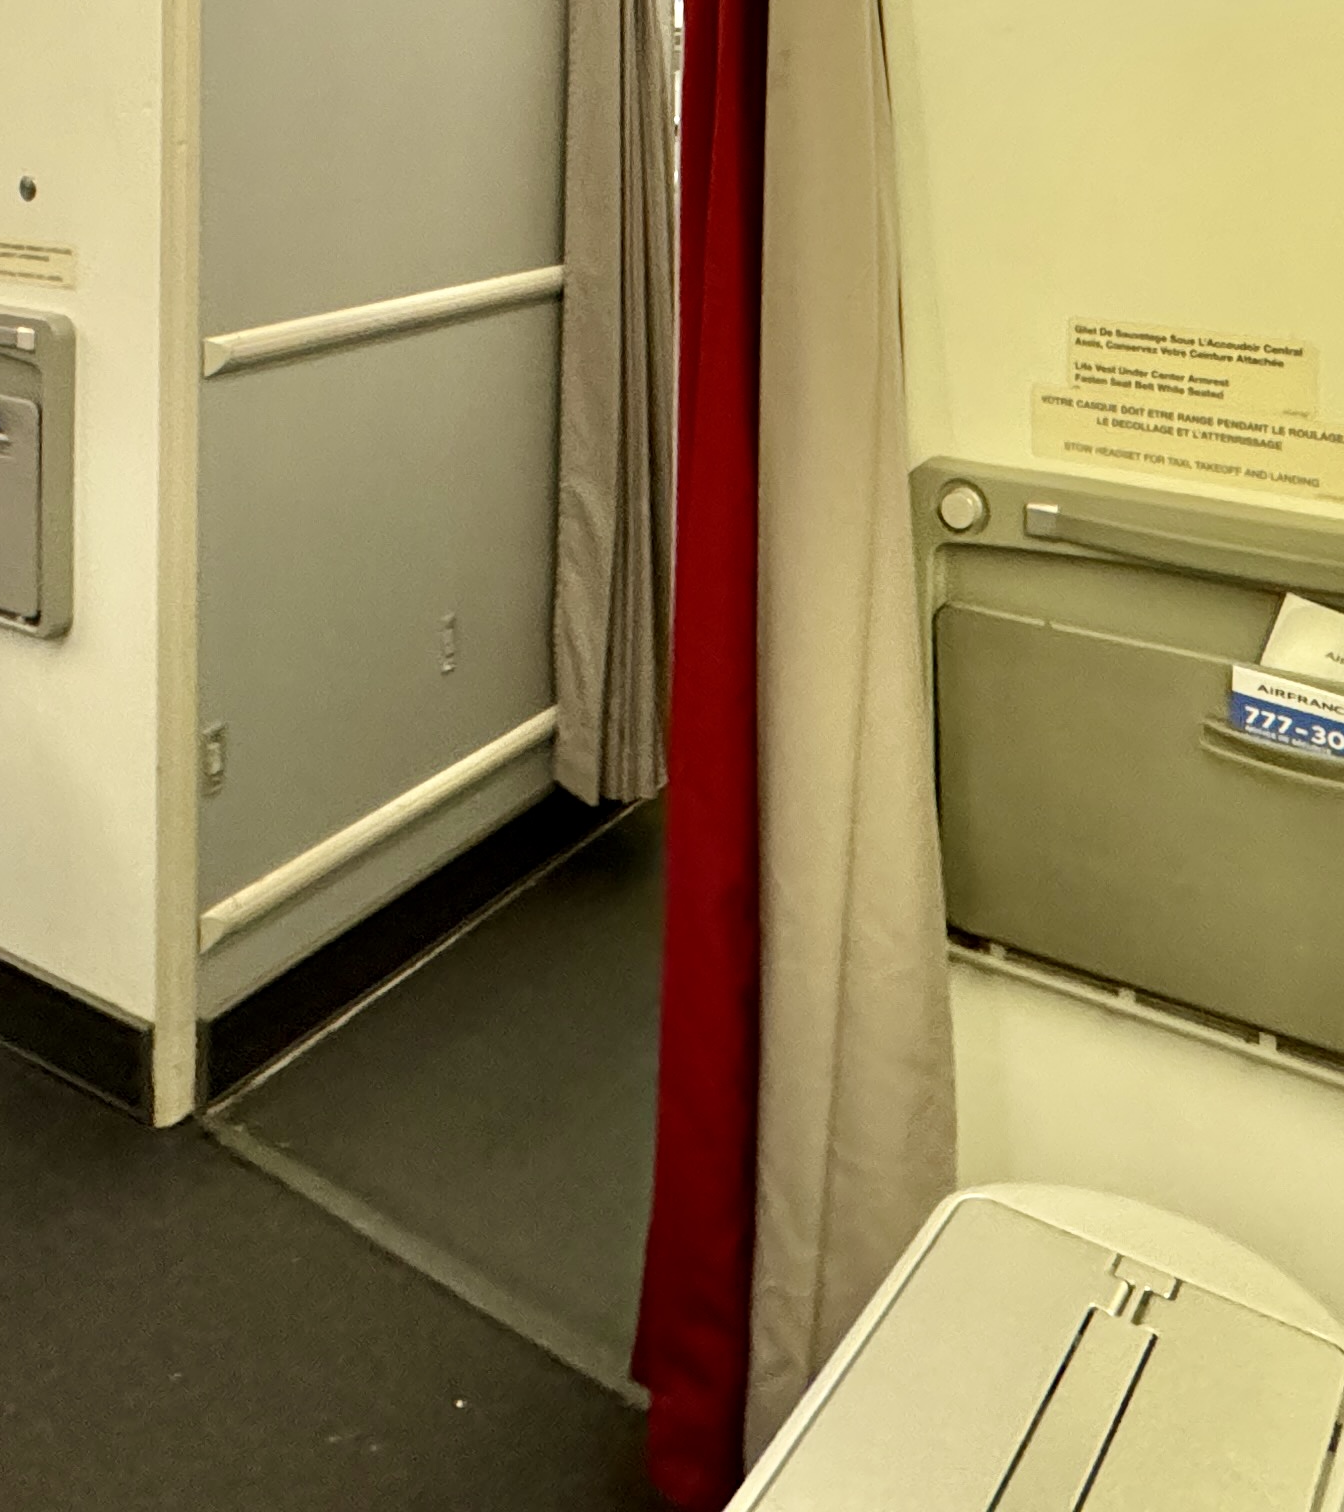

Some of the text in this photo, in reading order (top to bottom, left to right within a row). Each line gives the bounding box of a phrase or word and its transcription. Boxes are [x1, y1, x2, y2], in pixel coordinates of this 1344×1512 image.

[1100, 327, 1113, 337] De
[1170, 334, 1195, 346] Sous
[1264, 344, 1303, 356] Central
[1160, 347, 1187, 358] Votre
[1074, 361, 1093, 371] Life
[1095, 364, 1116, 374] Vest
[1118, 366, 1148, 378] Under
[1151, 370, 1185, 381] Center
[1041, 395, 1074, 407] VOTRE
[1076, 399, 1118, 413] CASQUE
[1121, 405, 1146, 417] DOIT
[1217, 418, 1269, 433] PENDANT
[1272, 426, 1286, 436] LE
[1096, 417, 1109, 427] LE
[1176, 427, 1190, 437] ET
[1064, 441, 1093, 454] STOW
[1095, 446, 1142, 461] HEADSET
[1144, 453, 1166, 465] FOR
[1194, 461, 1242, 476] TAKEOFF
[1244, 468, 1268, 480] AND
[1270, 472, 1321, 488] LANDING
